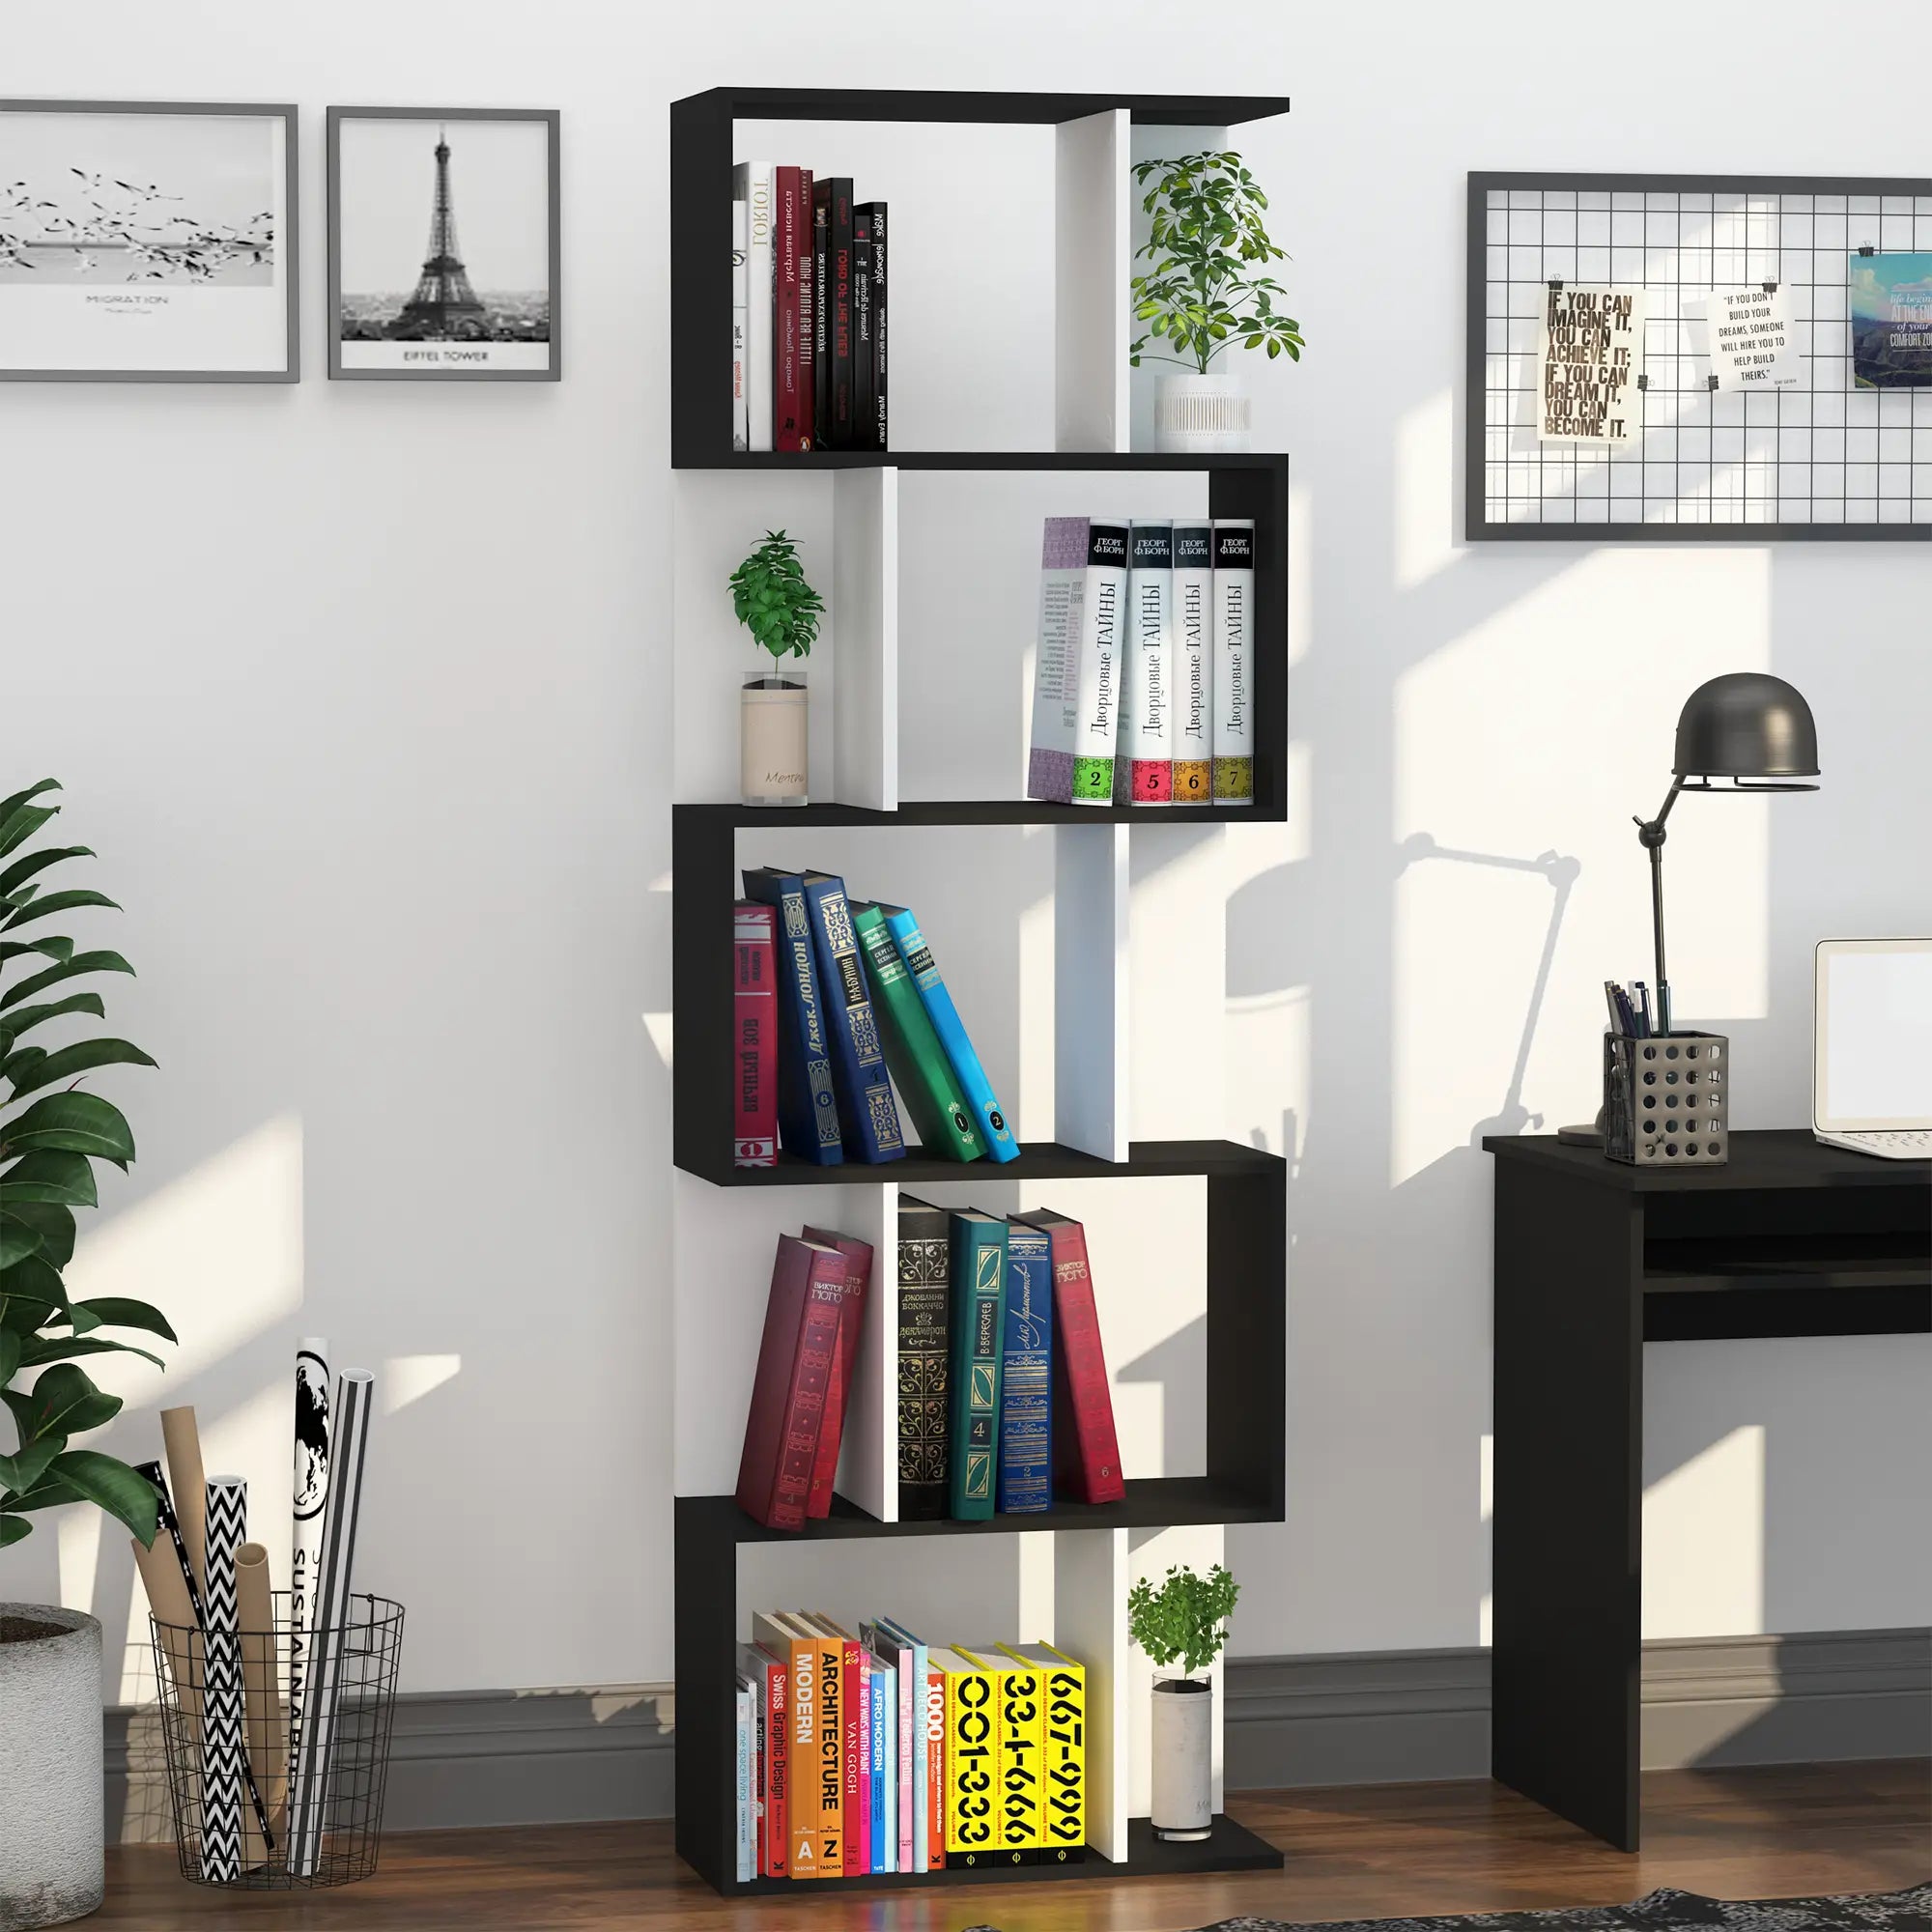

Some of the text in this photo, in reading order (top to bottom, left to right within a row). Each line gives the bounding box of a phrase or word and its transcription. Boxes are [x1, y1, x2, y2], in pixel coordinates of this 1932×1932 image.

[85, 295, 170, 304] MIGRATION
[1548, 291, 1633, 313] IF YOU CAN
[1736, 294, 1750, 304] YOU
[1890, 293, 1905, 305] life
[1548, 309, 1632, 333] IMAGINE IT,
[1728, 307, 1772, 321] BUILD YOUR
[1902, 305, 1918, 323] THE
[1918, 305, 1932, 323] EN
[1548, 327, 1610, 348] YOU CAN
[1719, 321, 1785, 337] DREAMS, SOMEONE
[1896, 323, 1930, 333] of your
[1720, 336, 1785, 353] WILL HIRE YOU TO
[1889, 332, 1932, 348] COMFORT ZO
[403, 351, 490, 362] EIFFEL TOWER
[1546, 345, 1631, 368] ACHIEVE IT;
[1733, 353, 1775, 366] HELP BUILD
[1545, 363, 1628, 385] IF YOU CAN
[1545, 382, 1621, 405] DREAM IT,
[1545, 399, 1606, 419] YOU CAN
[1544, 416, 1627, 438] BECOME IT.
[1096, 537, 1122, 547] ГЕОРГ
[1137, 539, 1167, 548] ГЕОРГ
[1222, 538, 1247, 547] ГЕОРГ
[1090, 582, 1117, 736] Дворцовые ТАЙНЫ
[1138, 582, 1166, 738] Дворцовые ТАЙНЫ
[1181, 582, 1206, 739] Дворцовые ТАЙНЫ
[1223, 583, 1246, 736] Дворцовые ТАЙНЫ
[1091, 772, 1101, 786] 2
[1147, 774, 1159, 790] 5
[1188, 774, 1199, 789] 6
[1228, 771, 1237, 786] 7
[793, 941, 825, 1056] Джек ЛОНДОН
[743, 1018, 759, 1046] ЗОВ
[819, 1094, 828, 1105] 6
[957, 1117, 964, 1127] 1
[993, 1115, 1001, 1126] 2
[748, 1143, 755, 1155] 1
[1057, 1268, 1088, 1283] ГЮГО
[811, 1289, 842, 1304] ГЮГО
[813, 1281, 844, 1293] ВИКТОР
[973, 1421, 985, 1437] 4
[1024, 1466, 1032, 1477] 2
[1102, 1466, 1110, 1477] 6
[796, 1653, 813, 1744] MODERN
[859, 1689, 870, 1707] NEW
[859, 1707, 870, 1729] WAYS
[927, 1683, 945, 1742] 1000
[770, 1674, 787, 1800] Swiss Graphic Design
[821, 1652, 838, 1810] ARCHITECTURE
[859, 1729, 870, 1750] WITH
[873, 1688, 883, 1772] AFRO MODERN
[917, 1723, 927, 1761] HOUSE
[738, 1747, 747, 1775] space
[847, 1720, 857, 1795] VAN GOGH
[859, 1750, 870, 1776] PAINT
[957, 1676, 990, 1845] 001-333
[1004, 1674, 1037, 1844] 334-666
[1049, 1672, 1083, 1841] 667-999
[737, 1776, 749, 1802] living
[797, 1841, 813, 1860] A
[823, 1839, 838, 1858] Z
